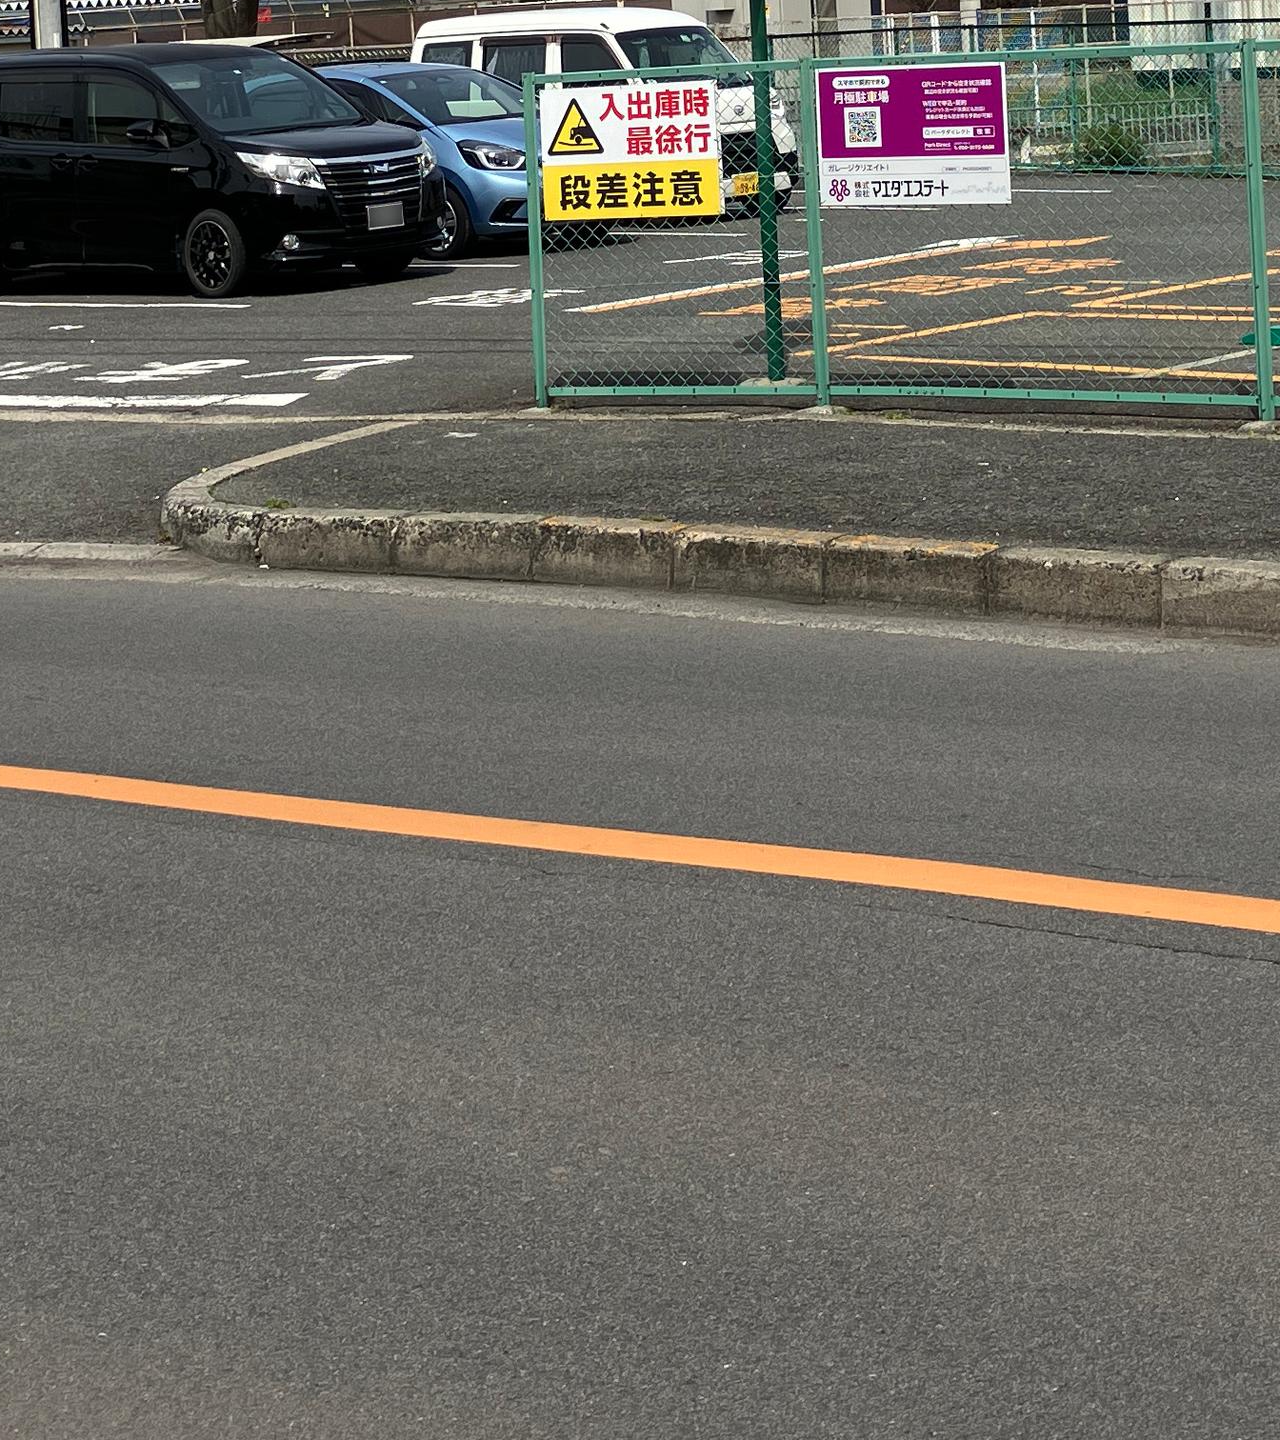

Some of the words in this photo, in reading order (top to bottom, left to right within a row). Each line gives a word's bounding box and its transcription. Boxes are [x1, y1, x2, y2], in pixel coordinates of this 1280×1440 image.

[599, 87, 710, 122] 入出庫時
[833, 90, 890, 105] 月極駐車場
[626, 123, 712, 156] 最徐行
[560, 170, 704, 211] 段差注意
[854, 181, 870, 189] 株式
[854, 190, 870, 198] 会社
[871, 179, 949, 198] マエダエステート
